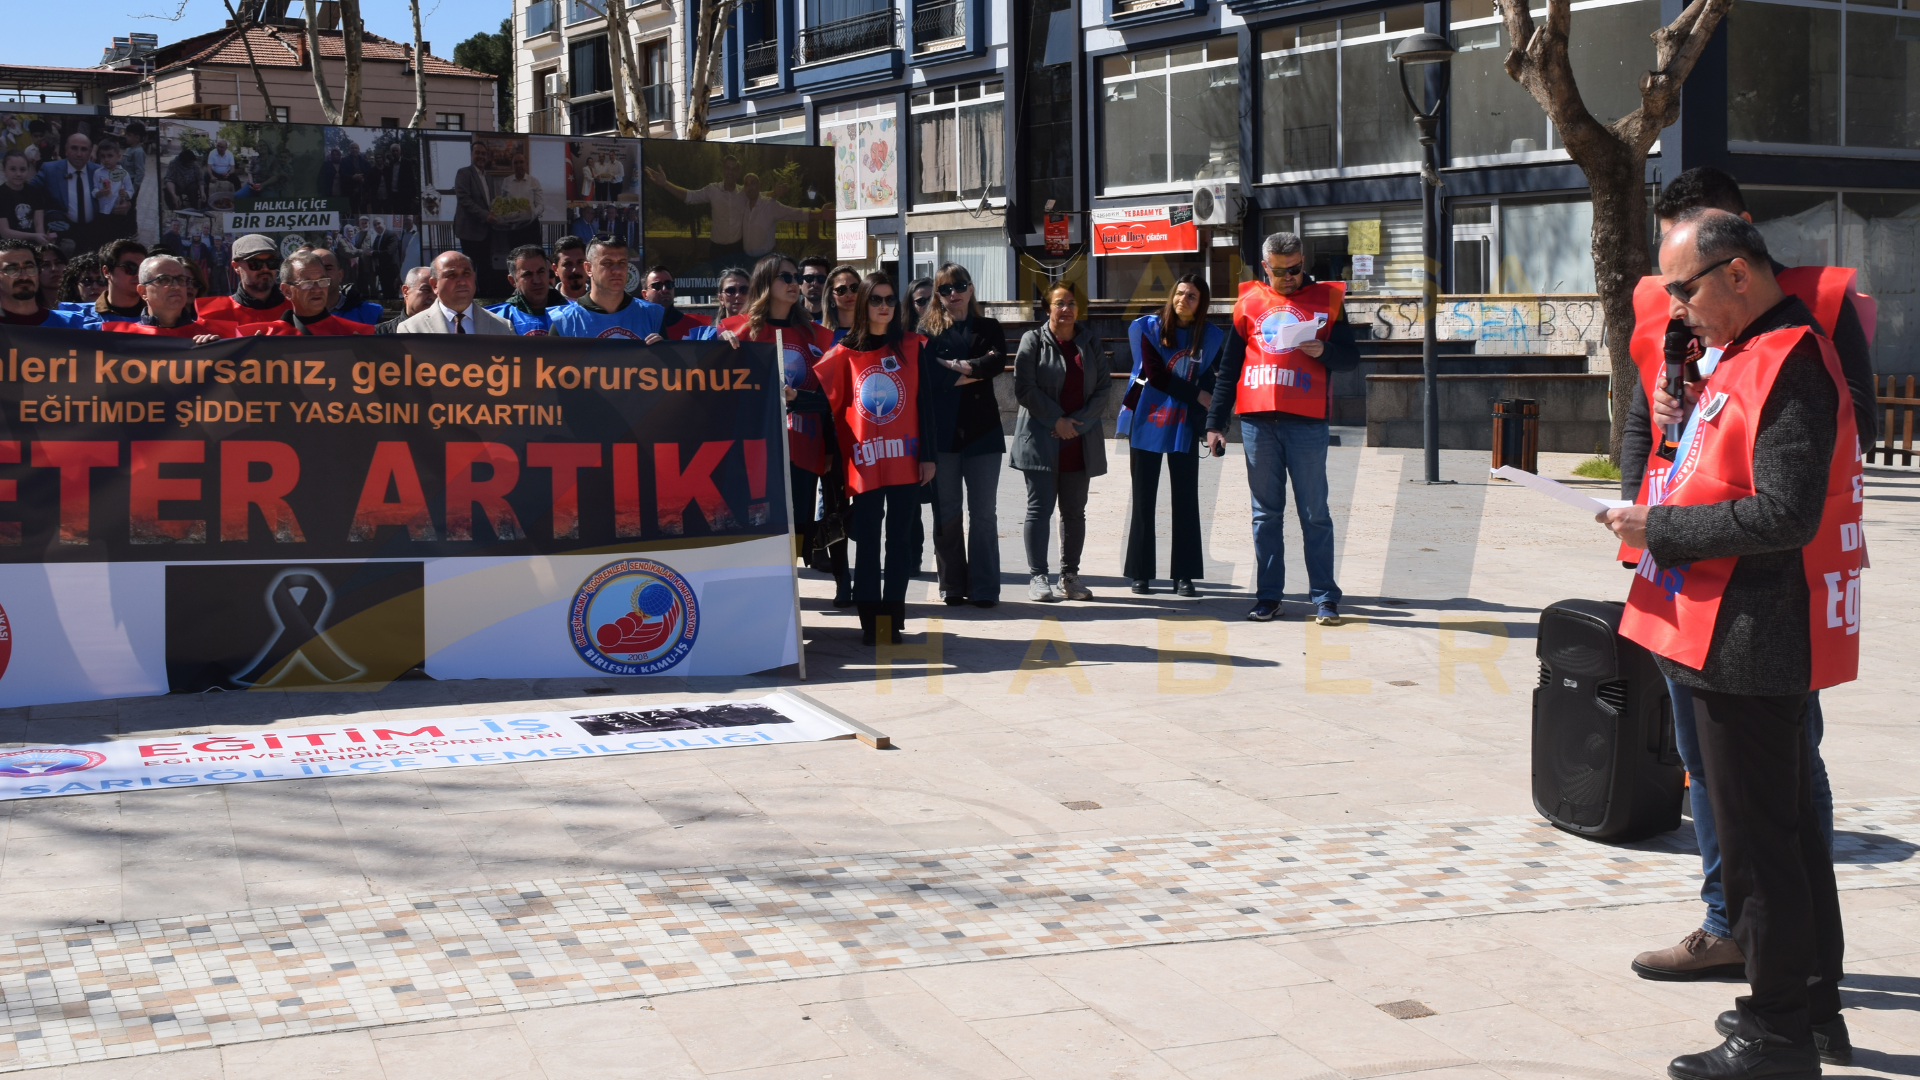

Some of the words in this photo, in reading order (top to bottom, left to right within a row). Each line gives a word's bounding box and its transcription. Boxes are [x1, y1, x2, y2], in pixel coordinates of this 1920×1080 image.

[254, 201, 295, 211] HALKLA
[297, 198, 308, 211] İÇ
[310, 197, 327, 211] İÇE
[1132, 208, 1154, 217] BABAM
[232, 213, 260, 228] BİR
[265, 213, 331, 230] BAŞKAN
[0, 348, 78, 384] leri
[95, 350, 337, 391] korursanız,
[351, 353, 521, 397] geleceği
[536, 356, 761, 391] korursunuz.
[19, 395, 166, 423] EĞİTİMDE
[175, 396, 282, 427] ŞİDDET
[289, 401, 419, 425] YASASINI
[427, 402, 563, 430] ÇIKARTIN!
[0, 440, 307, 546] TER
[347, 439, 771, 542] ARTIK!
[629, 561, 675, 582] SENDİKALARI
[672, 577, 697, 640] KONFEDERASYONU
[584, 648, 636, 674] BİRLEŞİK
[640, 642, 689, 673] KAMU-İŞ
[628, 653, 649, 661] 2008
[138, 718, 550, 758] EĞİTİM-İŞ
[248, 752, 286, 760] VE
[295, 746, 368, 757] BİLİM
[409, 732, 563, 748] GÖRENLERİ
[20, 768, 284, 796] SARIGÖL
[299, 757, 422, 775] İLÇE
[435, 731, 775, 764] TEMSİLCİLİĞİ
[290, 747, 439, 764] SENDİKASI
